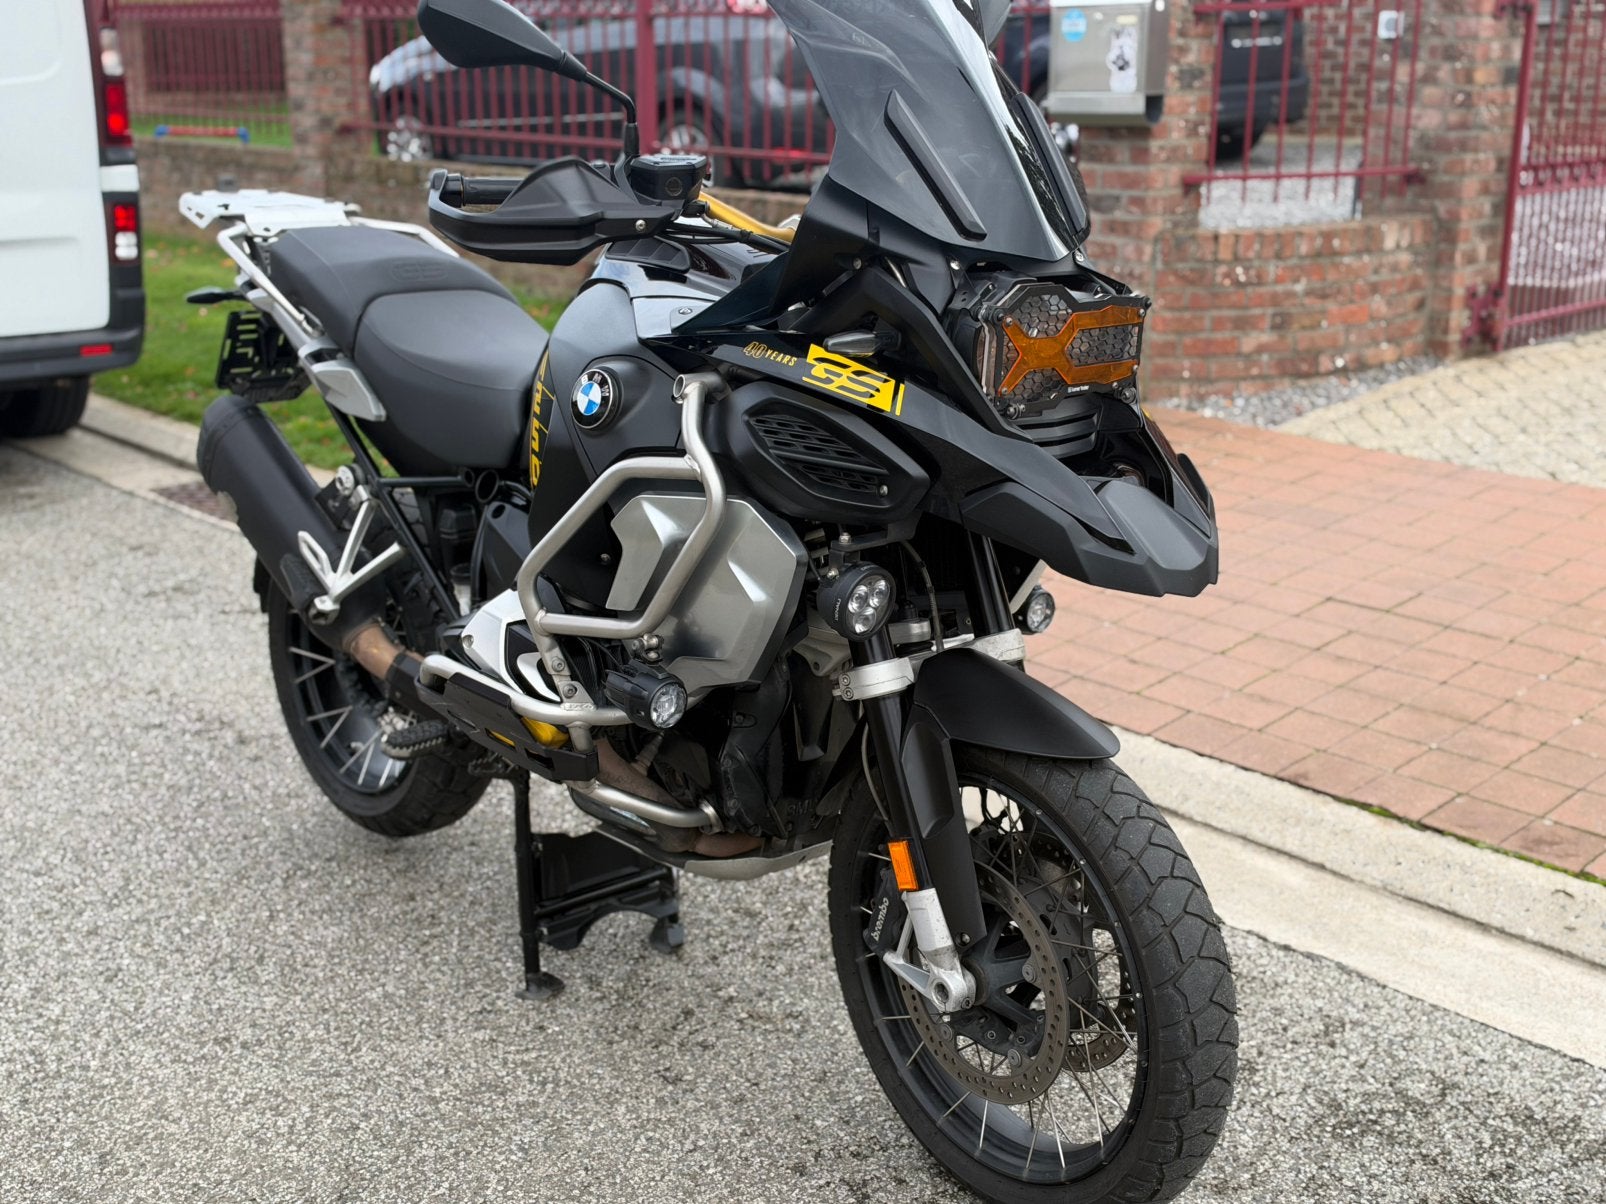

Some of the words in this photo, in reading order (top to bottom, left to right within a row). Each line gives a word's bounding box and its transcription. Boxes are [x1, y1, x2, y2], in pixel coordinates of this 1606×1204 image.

[743, 341, 768, 359] 40
[765, 349, 798, 367] YEARS
[580, 372, 610, 397] BMW
[804, 354, 894, 404] GS
[870, 897, 890, 942] brembo
